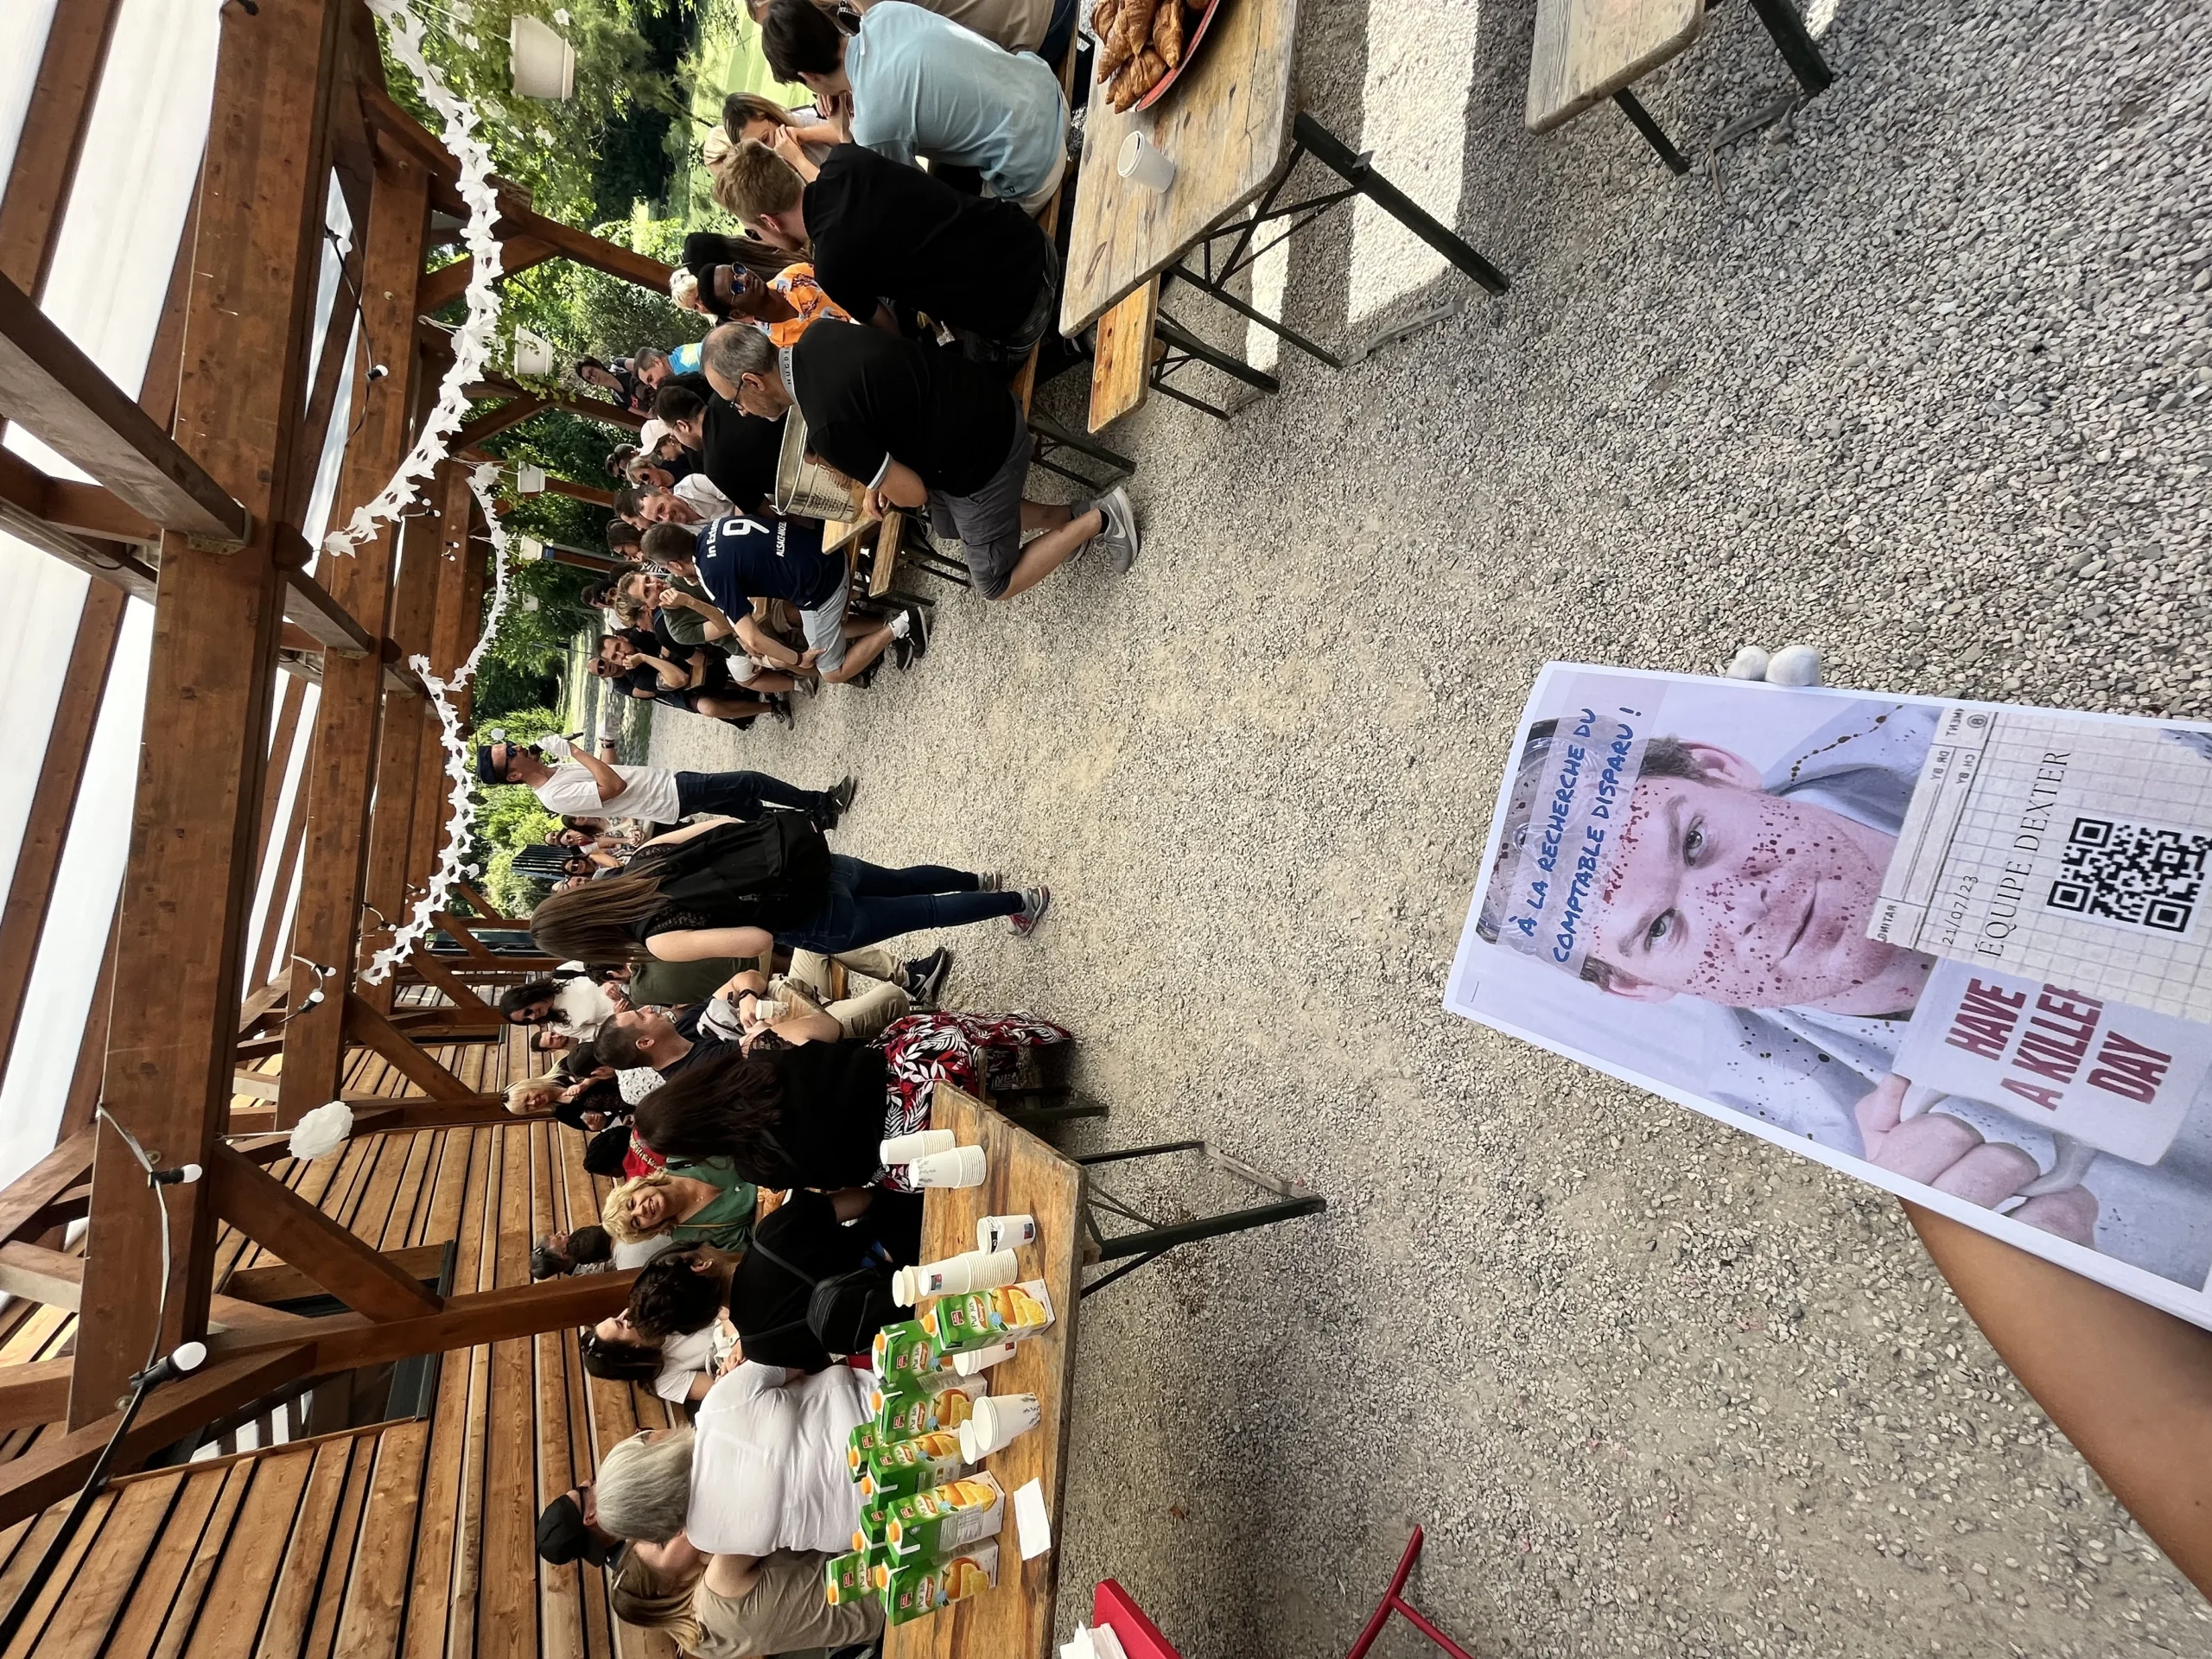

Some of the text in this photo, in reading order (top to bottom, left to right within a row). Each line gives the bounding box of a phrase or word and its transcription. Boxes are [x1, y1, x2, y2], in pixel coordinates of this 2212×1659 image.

[706, 544, 717, 559] In
[721, 518, 771, 537] 9
[1509, 708, 1597, 937] À LA RECHERCHE DU
[1553, 825, 1605, 963] COMPTABLE
[1591, 723, 1634, 819] DISPARU
[1974, 751, 2072, 957] ÉQUIPE DEXTER
[1942, 875, 1979, 946] 21/07/23
[1944, 977, 2027, 1061] HAVE
[2000, 1077, 2063, 1112] A
[2087, 1030, 2172, 1105] DAY
[968, 1302, 977, 1313] jus
